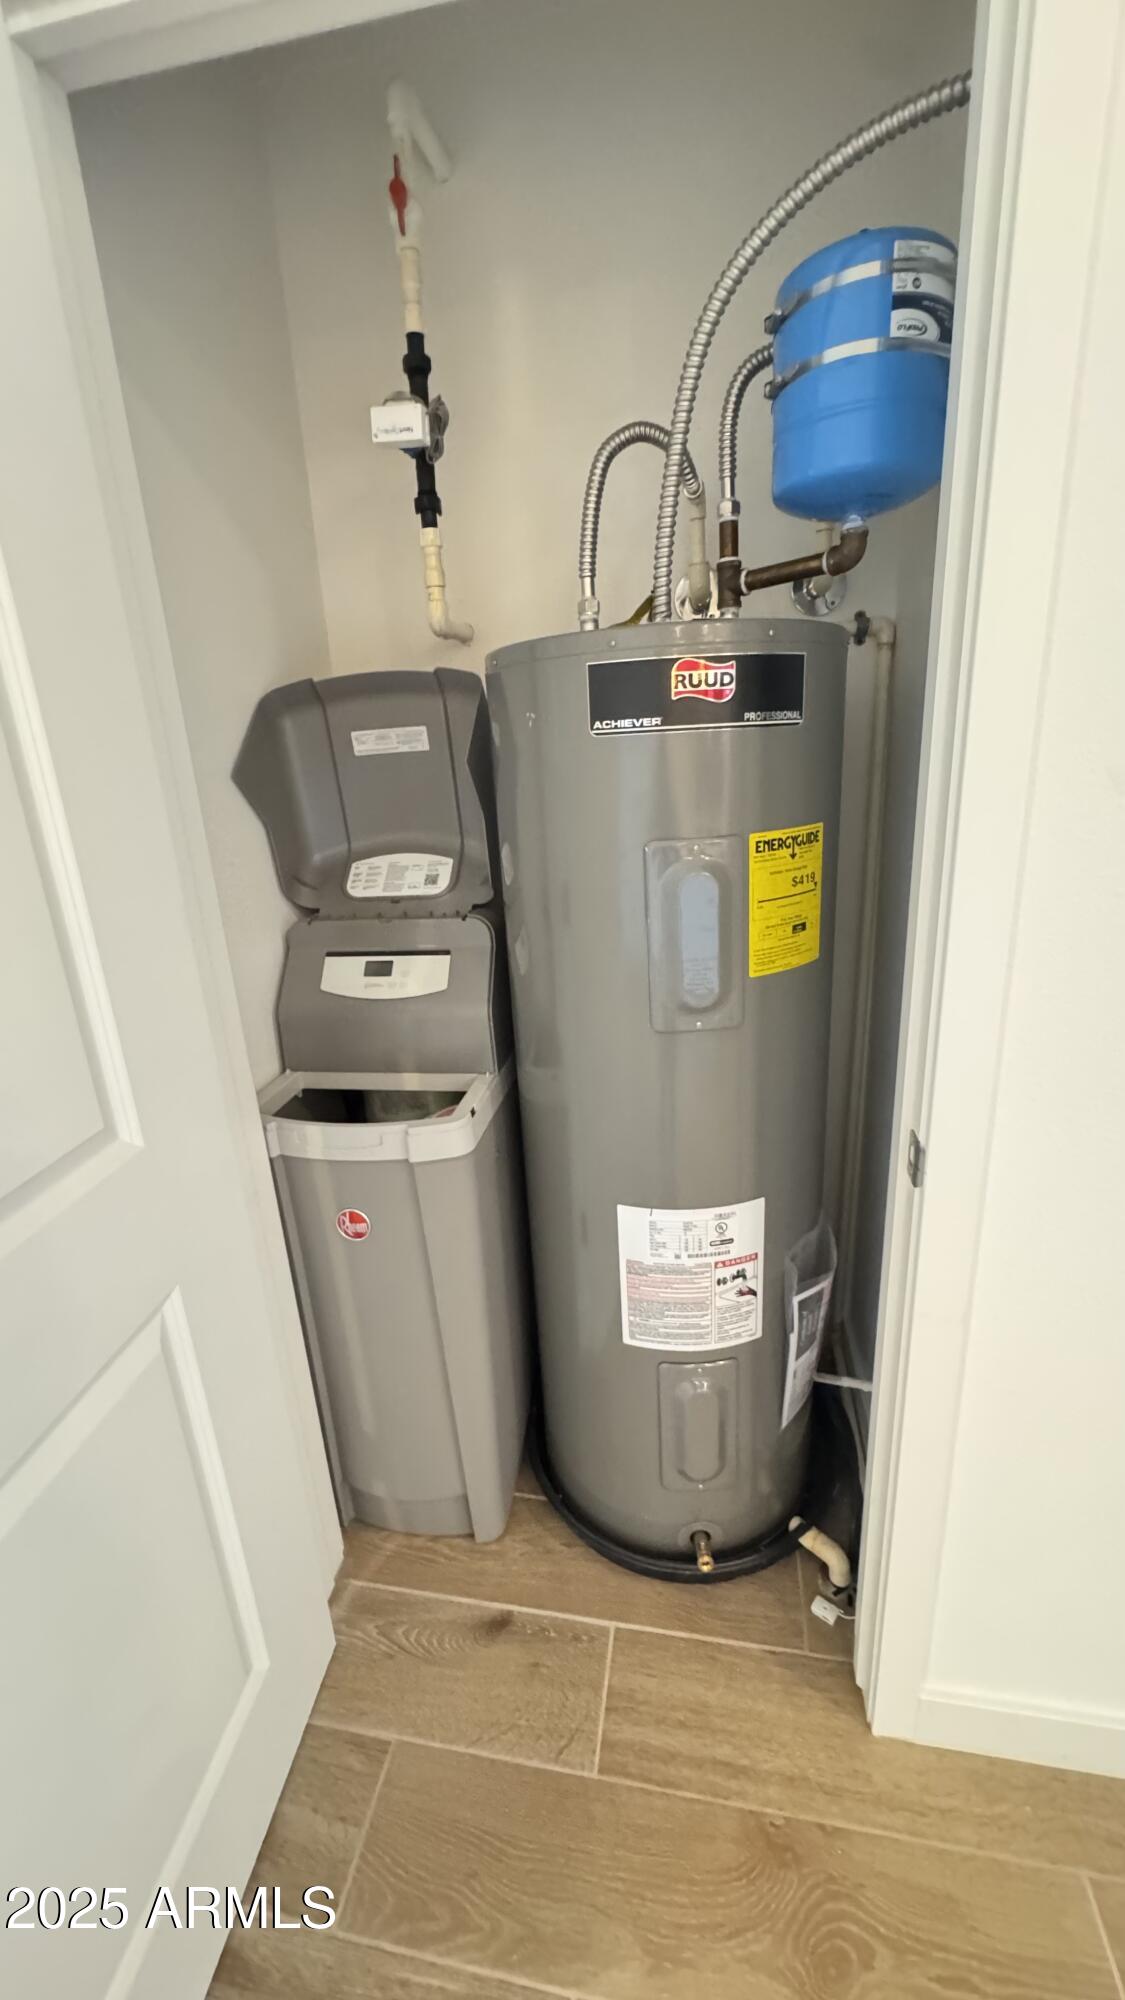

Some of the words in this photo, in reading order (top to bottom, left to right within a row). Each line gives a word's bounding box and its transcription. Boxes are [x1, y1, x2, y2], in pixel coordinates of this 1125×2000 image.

[673, 671, 735, 689] RUUD
[593, 717, 661, 729] ACHIEVER
[743, 710, 801, 722] PROFESSIONAL
[755, 830, 820, 854] ENERGYGUIDE
[724, 1253, 757, 1267] DANGER
